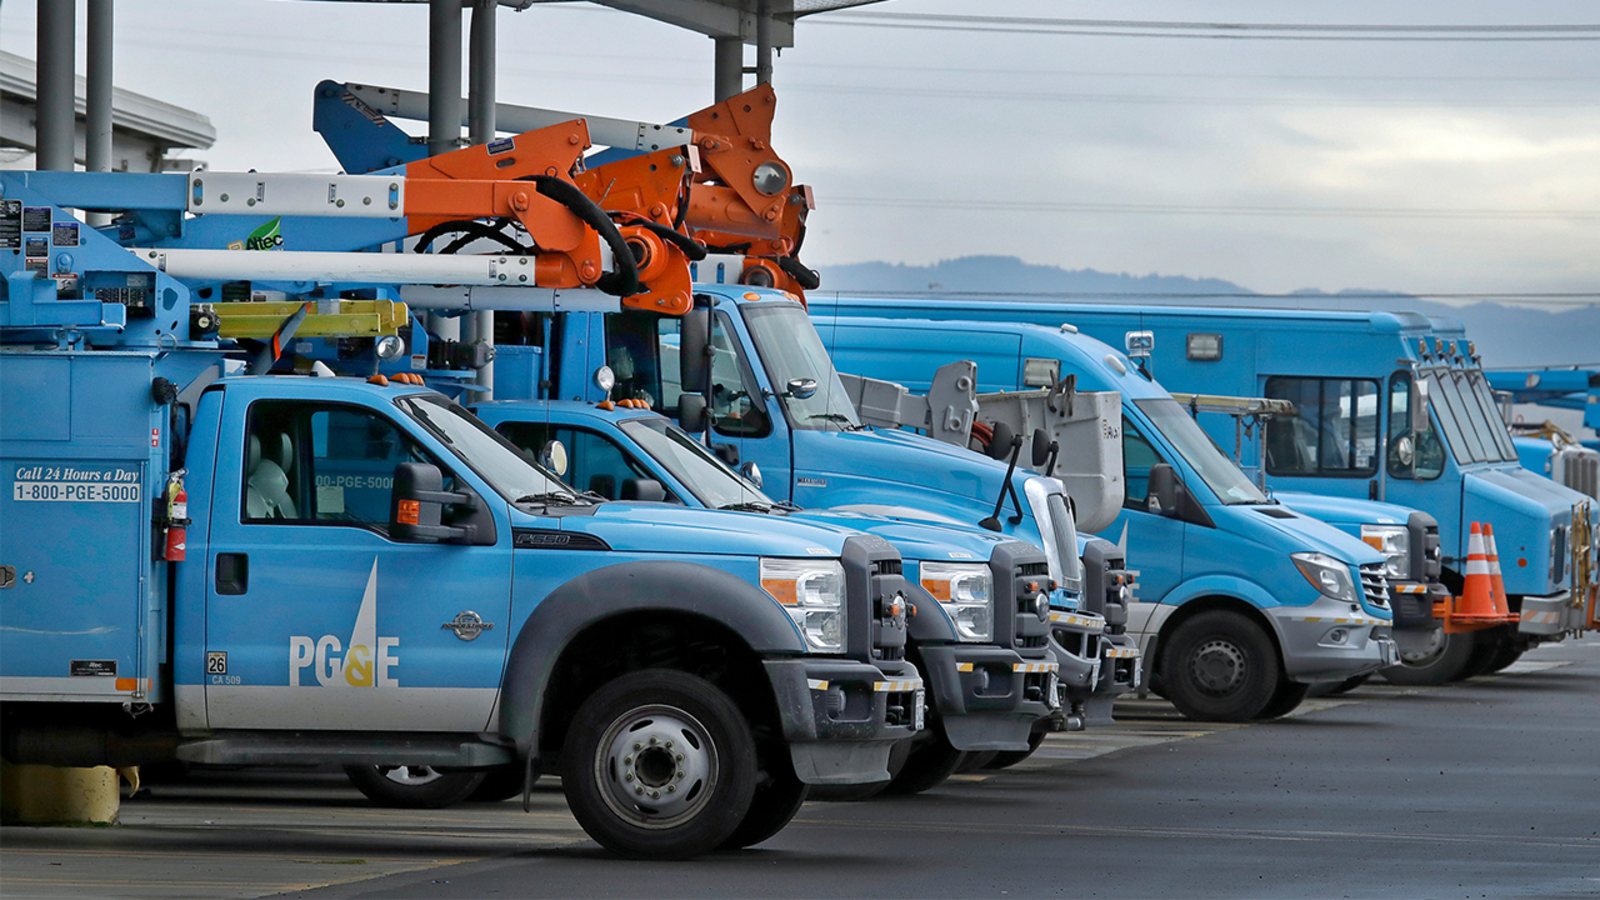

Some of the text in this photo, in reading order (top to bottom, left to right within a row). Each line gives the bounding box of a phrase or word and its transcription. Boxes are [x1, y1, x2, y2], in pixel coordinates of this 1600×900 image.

[246, 234, 284, 251] Altec
[16, 467, 139, 484] Call 24 Hours a Day
[16, 484, 138, 501] 1-800-PGE-5000
[209, 657, 225, 672] 26
[289, 634, 399, 688] PG&E
[212, 675, 241, 685] CA 509
